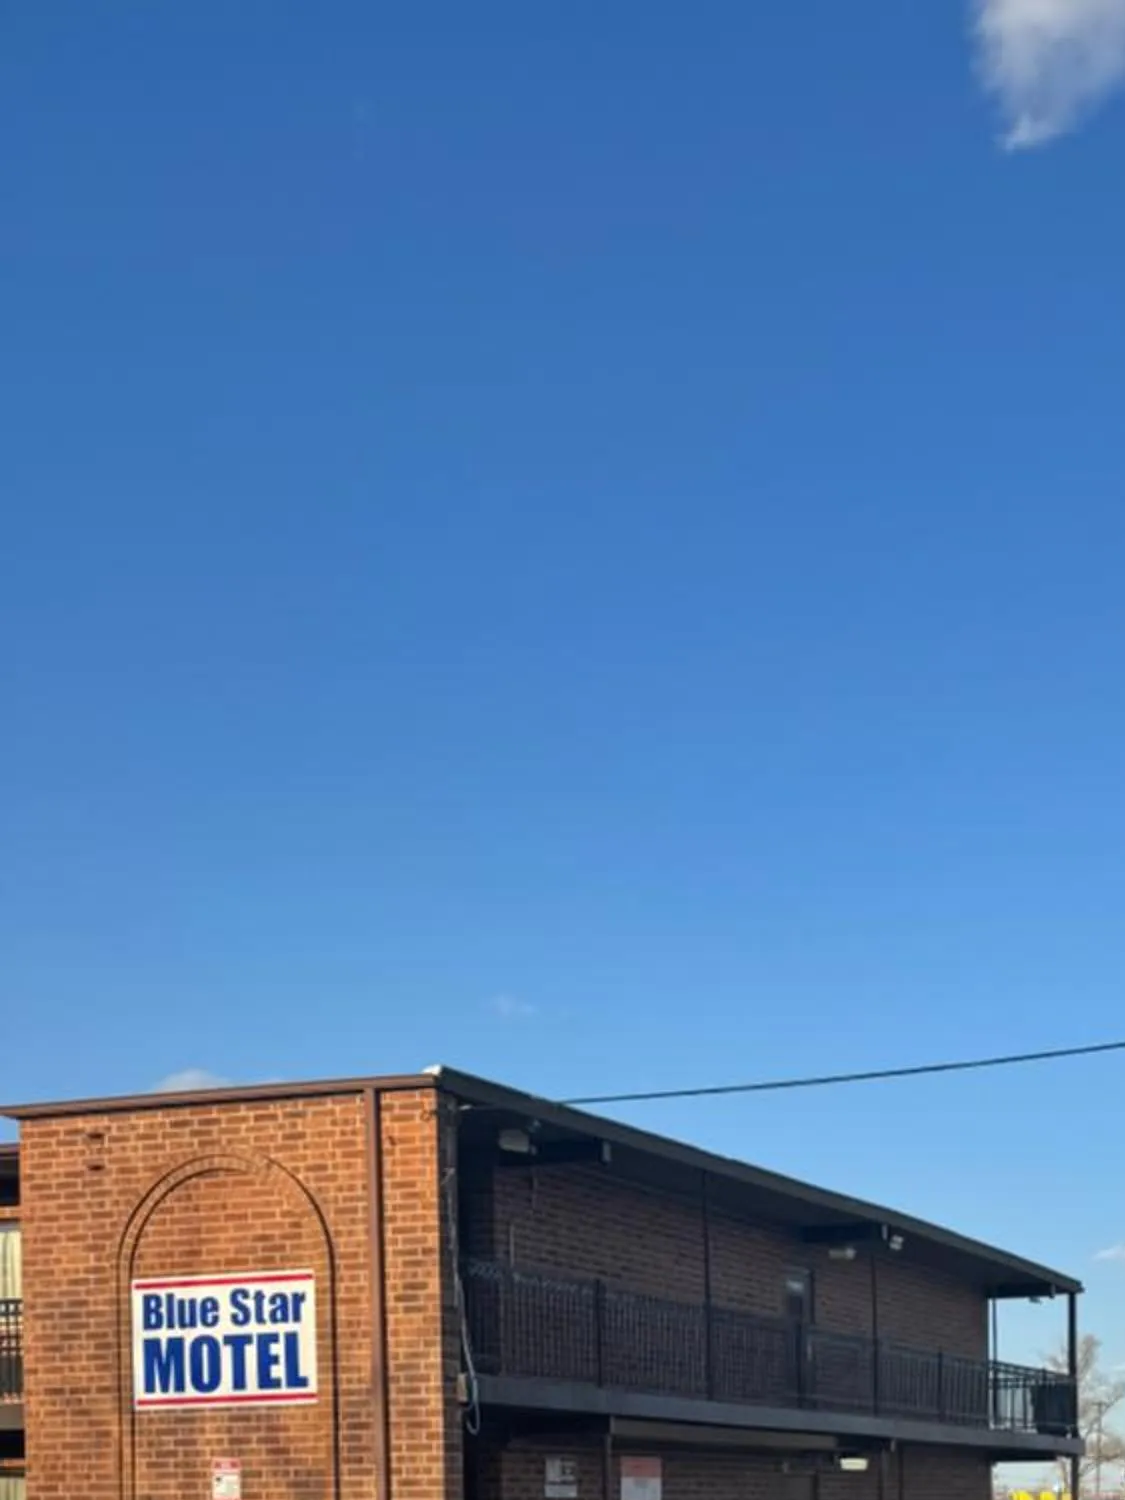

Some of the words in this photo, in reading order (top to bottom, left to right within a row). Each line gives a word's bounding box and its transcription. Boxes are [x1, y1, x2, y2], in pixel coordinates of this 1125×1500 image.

[143, 1293, 219, 1331] Blue
[229, 1288, 306, 1327] Star
[143, 1331, 309, 1394] MOTEL
